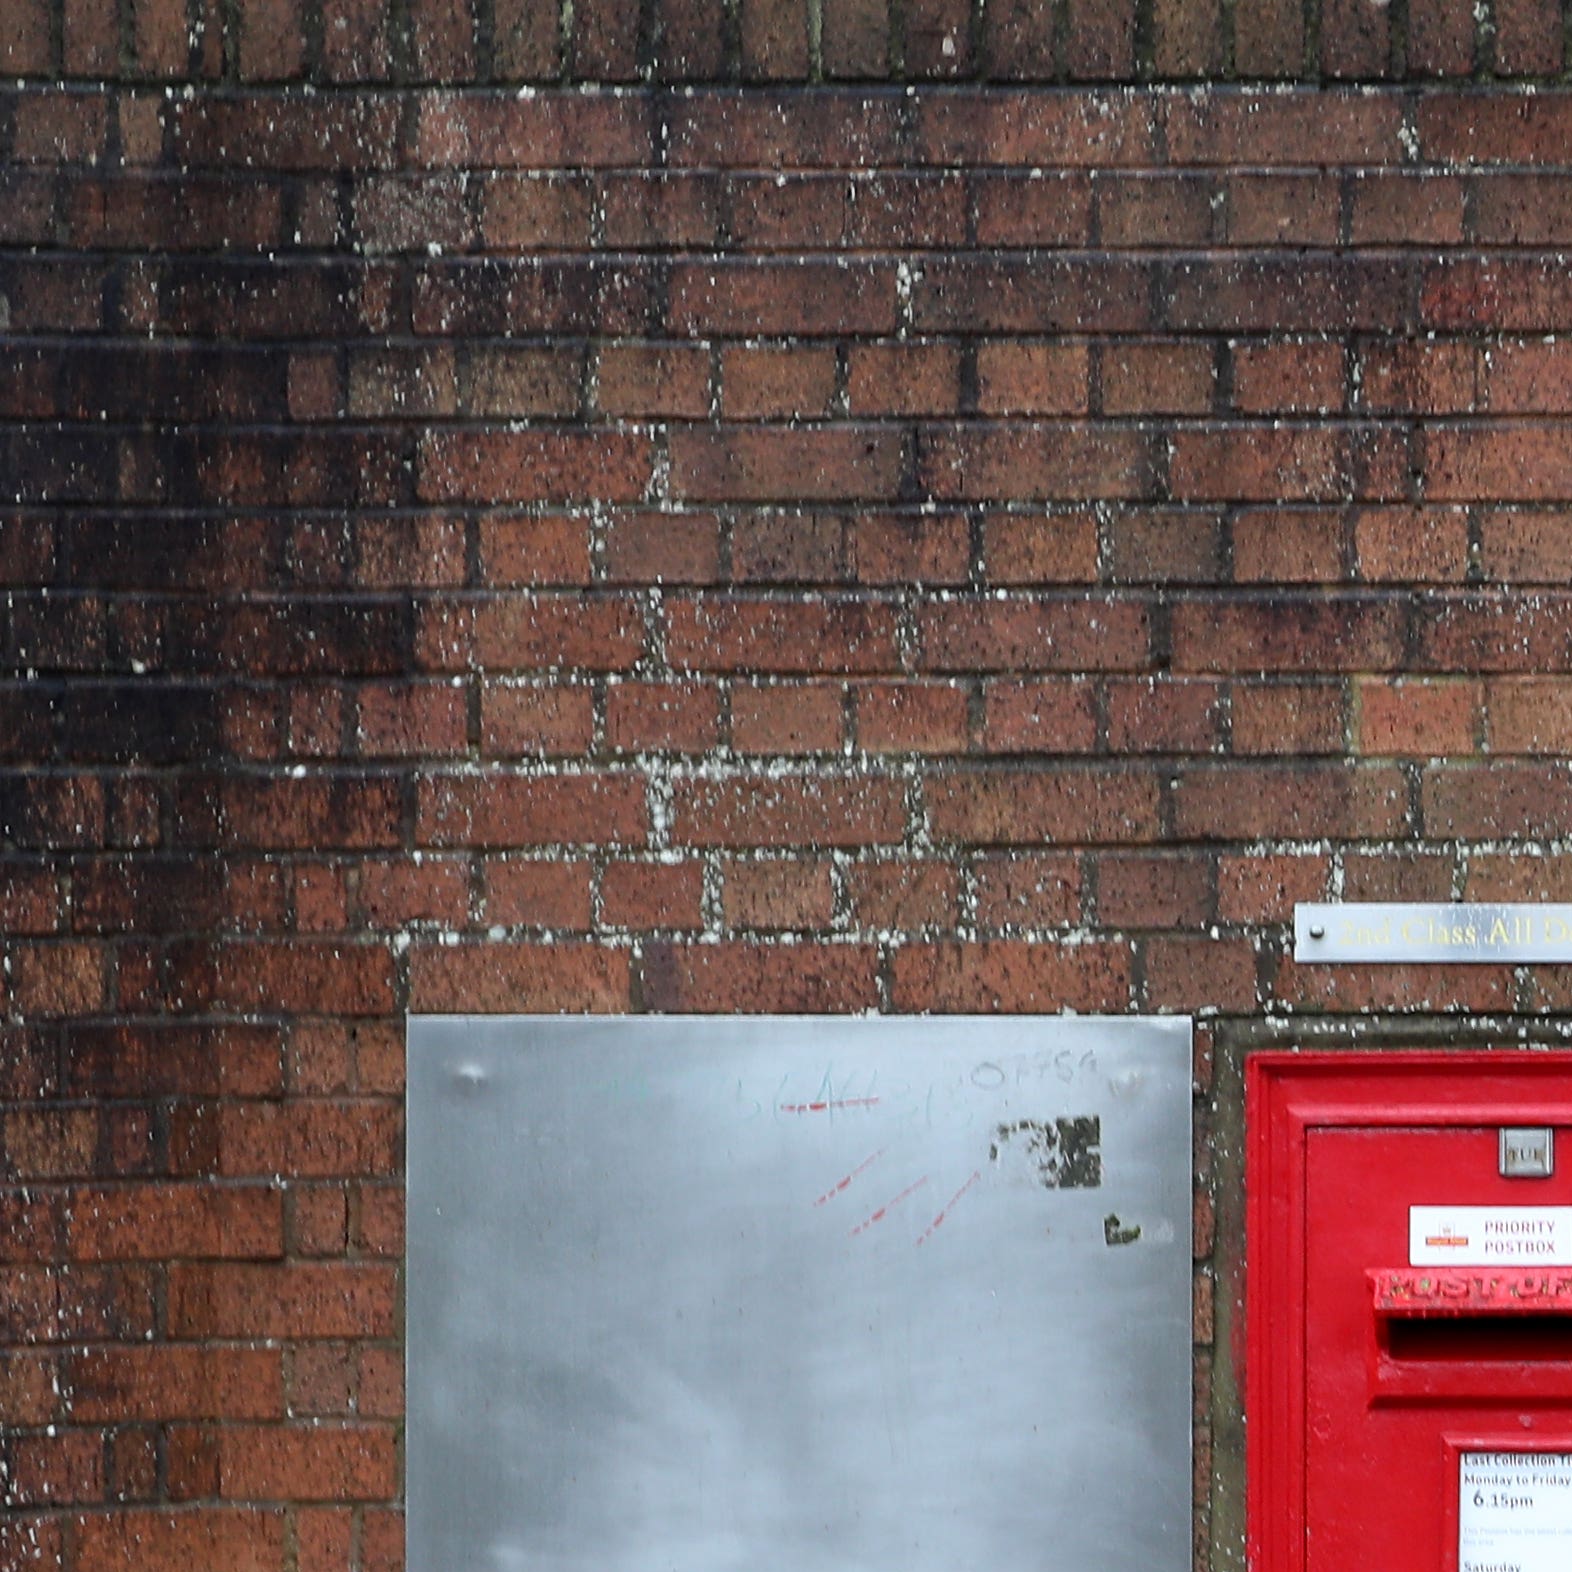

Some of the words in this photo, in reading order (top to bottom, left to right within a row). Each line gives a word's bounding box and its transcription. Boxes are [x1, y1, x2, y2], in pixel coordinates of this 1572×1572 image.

[1338, 919, 1391, 946] 2nd
[1401, 919, 1477, 946] Class
[1486, 918, 1533, 946] All
[1484, 1220, 1556, 1236] PRIORITY
[1484, 1239, 1556, 1255] POSTBOX
[1381, 1275, 1499, 1298] POST
[1463, 1454, 1491, 1468] Last
[1494, 1454, 1556, 1468] Collection
[1464, 1473, 1512, 1487] Monday
[1516, 1474, 1529, 1486] to
[1532, 1473, 1572, 1488] Friday
[1473, 1489, 1534, 1509] 6.15pm
